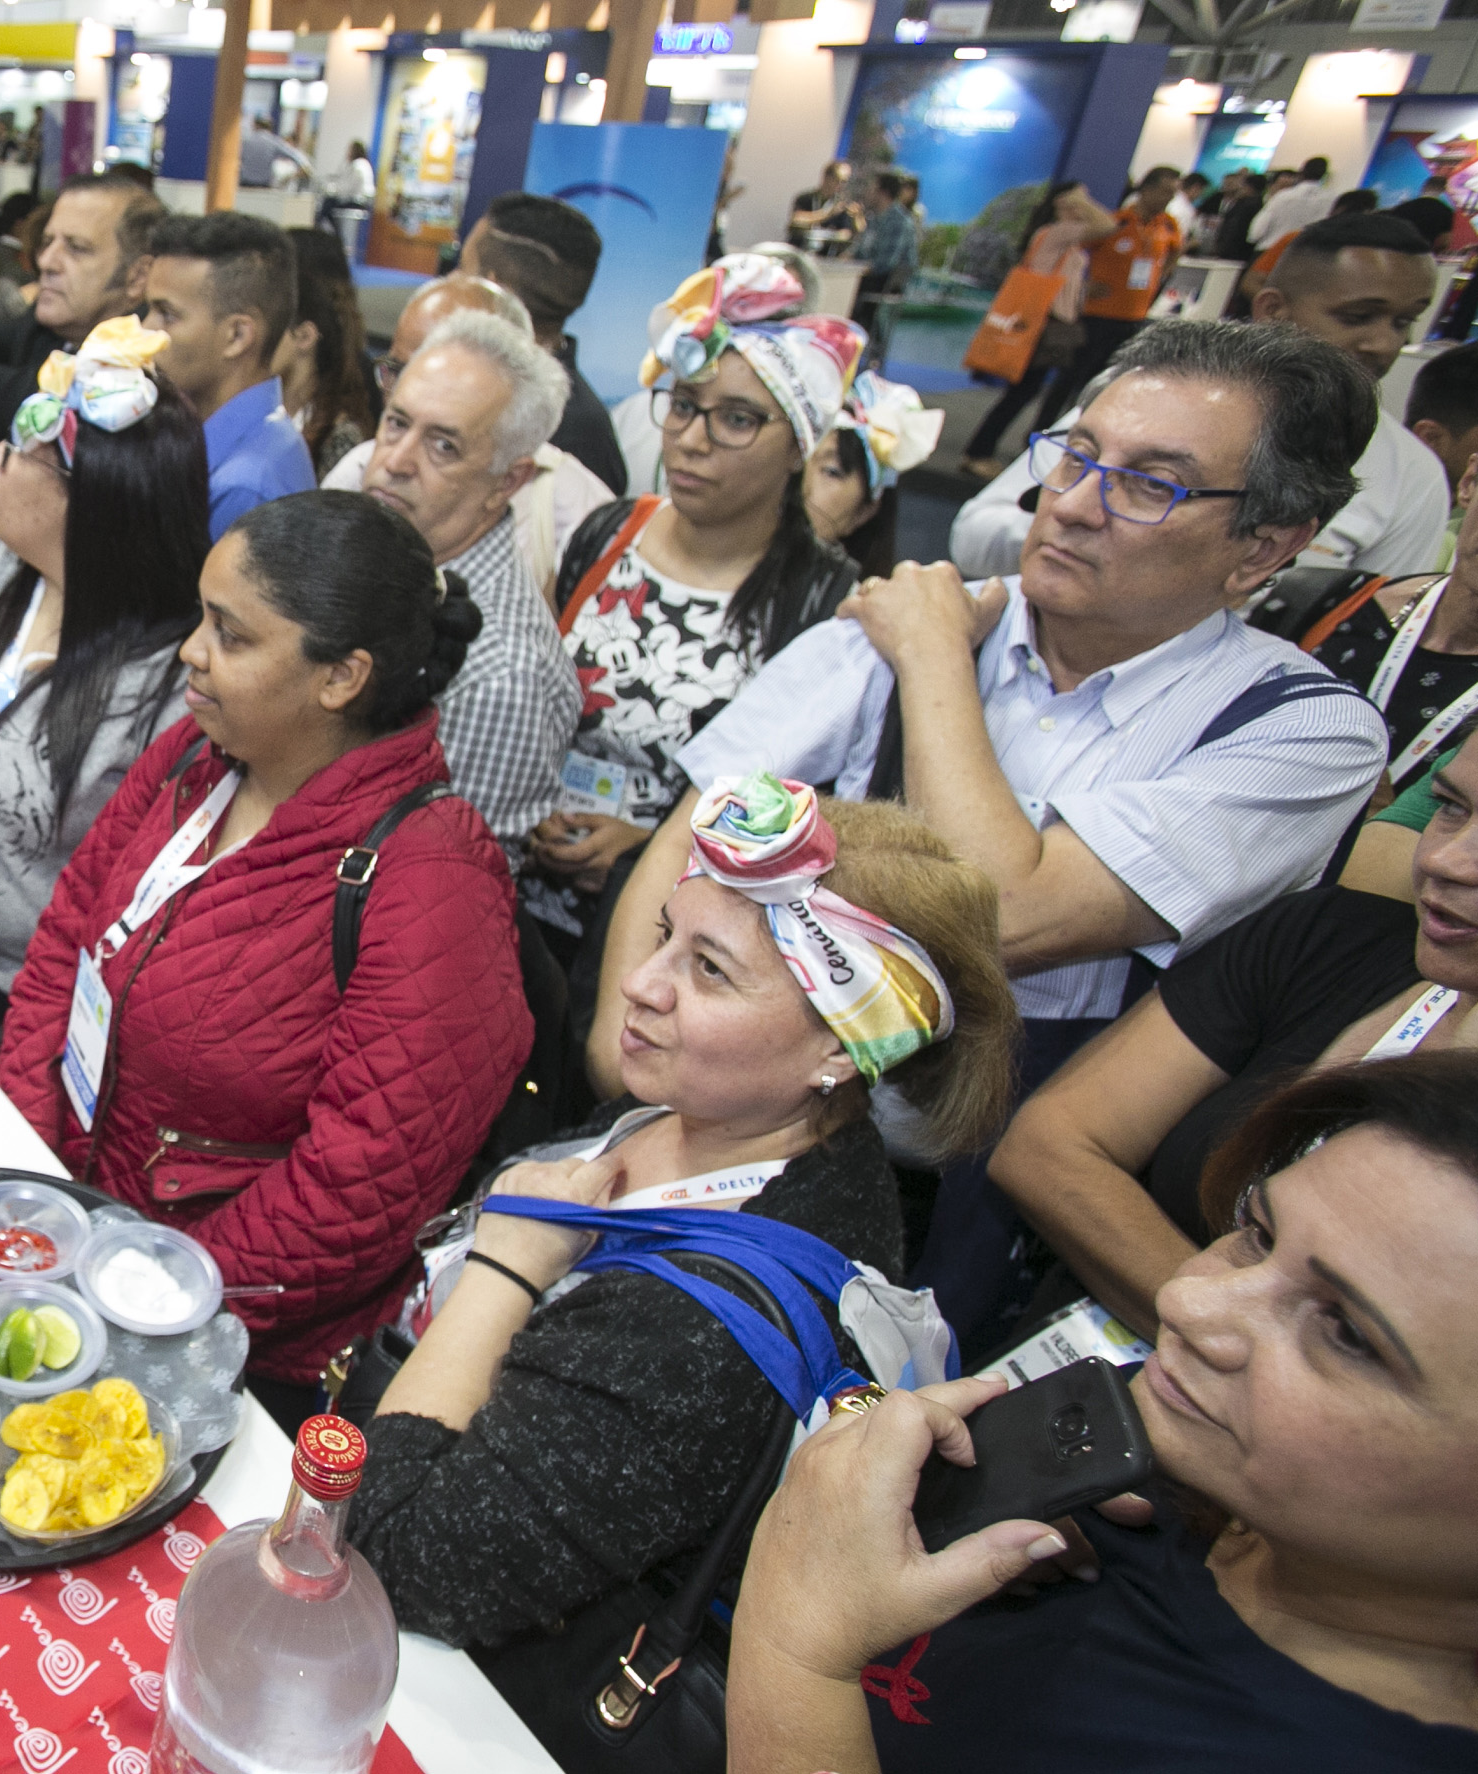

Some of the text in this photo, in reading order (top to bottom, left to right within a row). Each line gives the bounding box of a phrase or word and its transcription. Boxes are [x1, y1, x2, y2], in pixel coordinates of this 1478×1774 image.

[1397, 986, 1450, 1041] CE KLM
[718, 1176, 767, 1191] DELTA
[310, 1417, 328, 1430] ICA
[337, 1420, 362, 1444] PISCO
[305, 1428, 321, 1451] PERU
[327, 1445, 362, 1464] VARGAS
